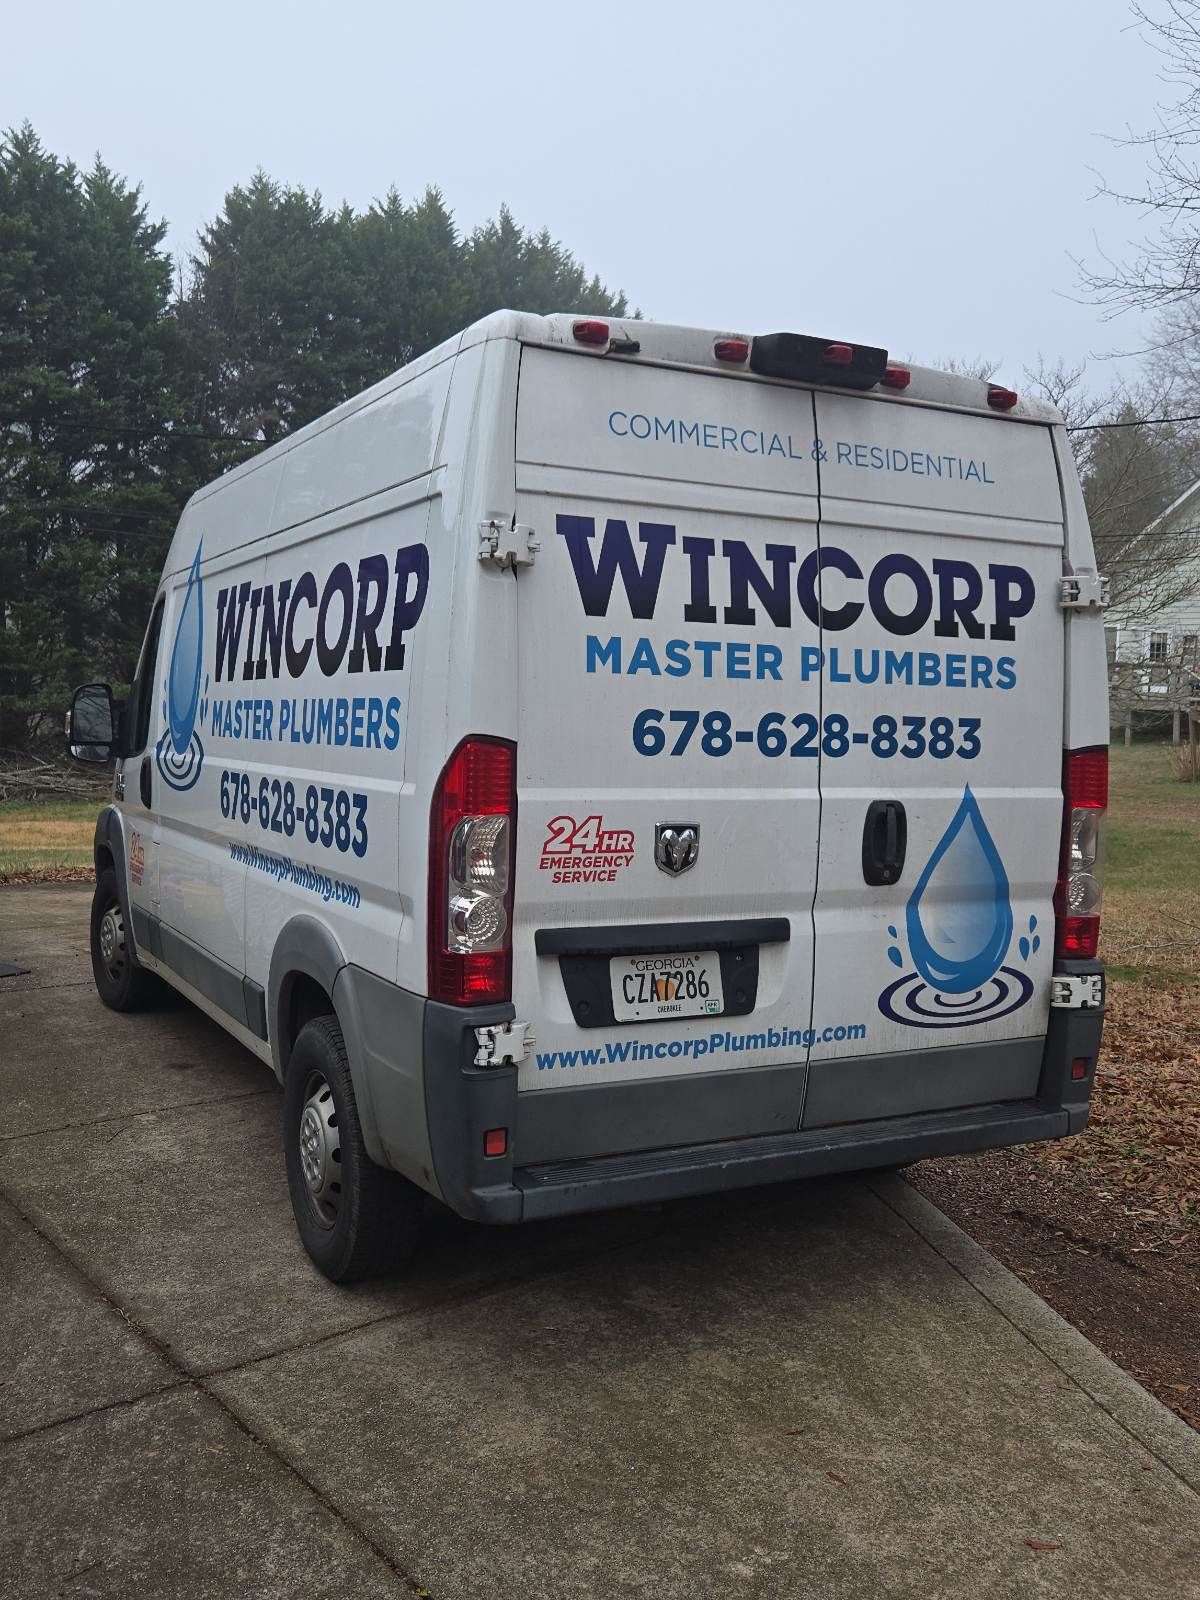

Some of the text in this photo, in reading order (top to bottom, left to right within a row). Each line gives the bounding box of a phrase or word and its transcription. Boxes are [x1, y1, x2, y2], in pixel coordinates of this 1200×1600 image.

[608, 411, 996, 484] COMMERCIAL & RESIDENTIAL
[556, 514, 1036, 642] WINCORP
[215, 542, 430, 682] WINCORP
[586, 635, 1017, 690] MASTER PLUMBERS
[211, 696, 401, 751] MASTER PLUMBERS
[633, 708, 982, 760] 678-628-8383
[220, 770, 369, 859] 678-628-8383
[228, 841, 361, 908] www.WincorpPlumbing.com
[540, 855, 634, 870] EMERGENCY
[552, 869, 618, 884] SERVICE
[622, 969, 710, 1005] CZA7286
[635, 958, 695, 972] GEORGIA
[657, 1004, 683, 1014] CHEROKEE
[536, 1021, 867, 1071] www.WincorpPlumbing.com
